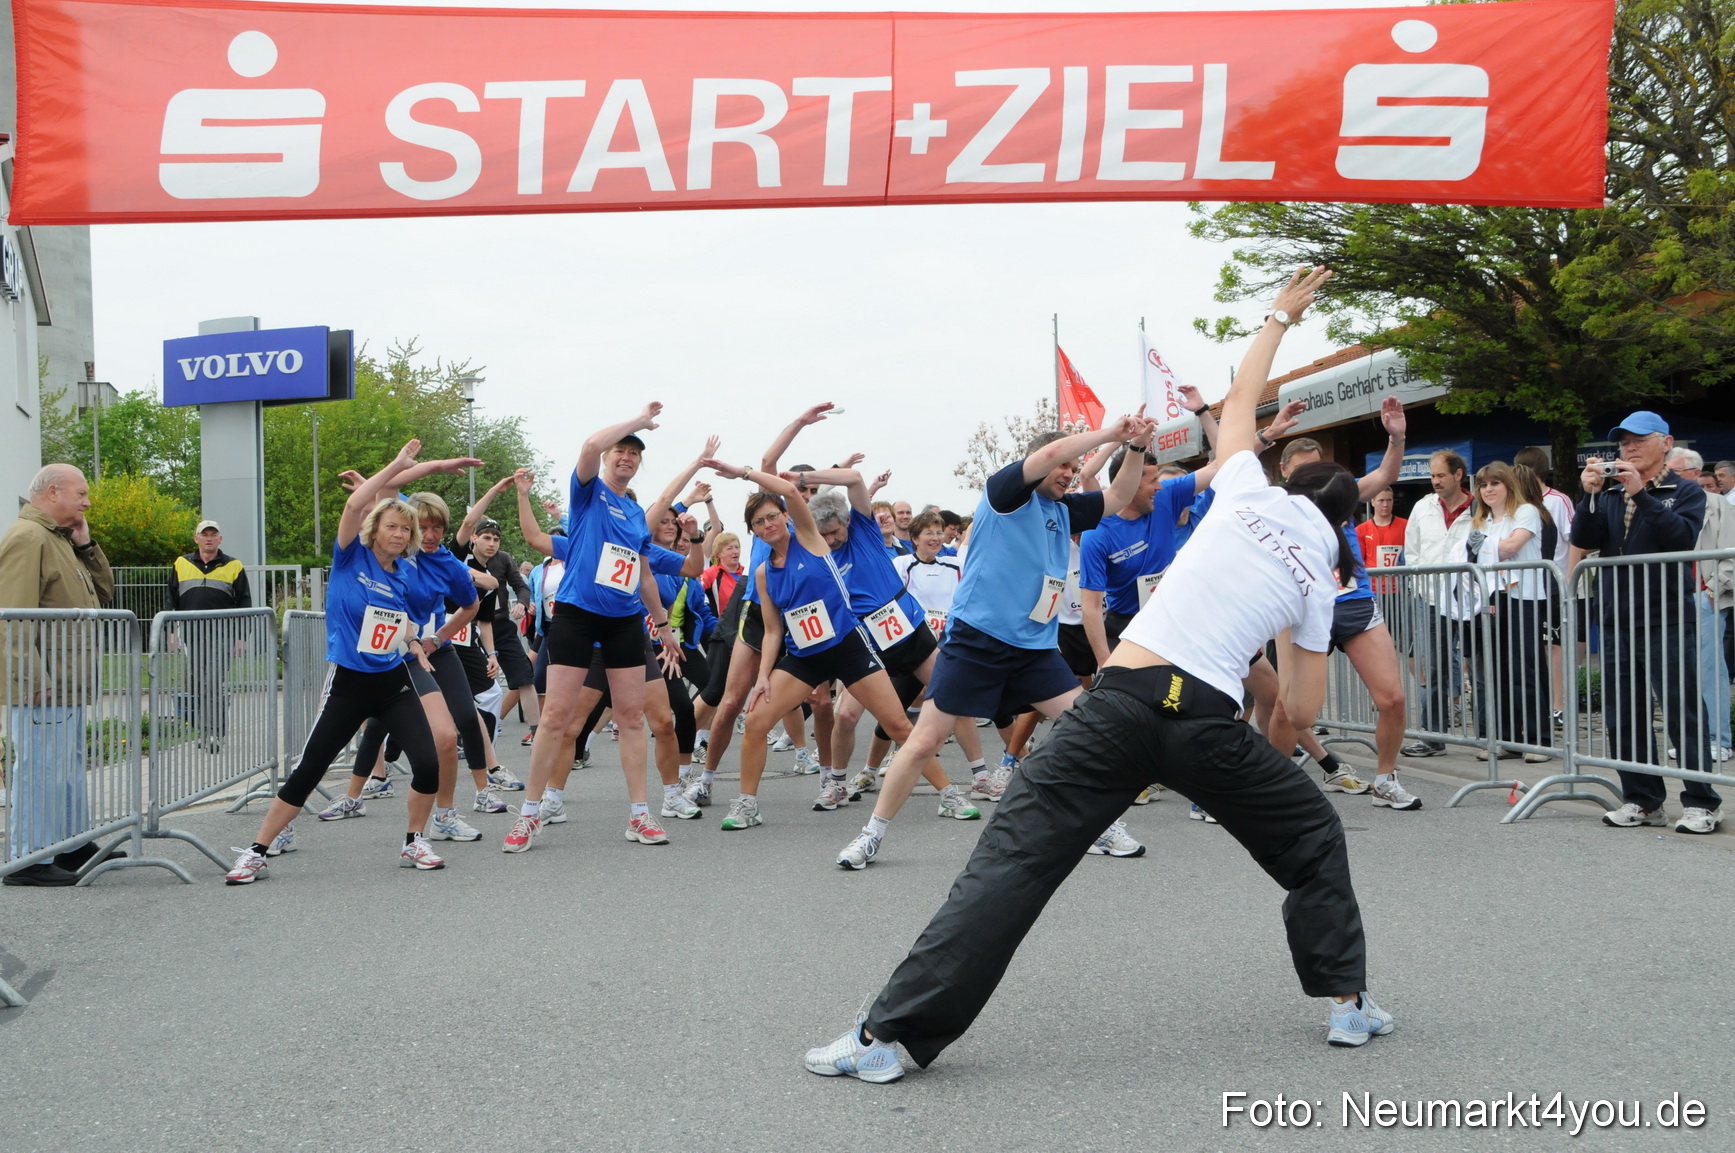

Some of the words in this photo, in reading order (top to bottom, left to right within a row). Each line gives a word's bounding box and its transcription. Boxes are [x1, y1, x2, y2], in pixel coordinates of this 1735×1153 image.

[177, 349, 304, 381] VOLVO
[1287, 391, 1335, 412] ohaus
[1337, 373, 1384, 401] Gerhart
[1387, 367, 1399, 388] &
[1157, 427, 1190, 452] SEAT
[611, 545, 631, 555] MEYER
[1383, 553, 1398, 567] 57
[611, 558, 635, 587] 21
[373, 609, 396, 619] MEYER
[790, 607, 808, 617] MEYER
[870, 608, 888, 621] MEYER
[1047, 592, 1058, 618] 1
[371, 623, 398, 650] 67
[799, 615, 824, 641] 10
[878, 615, 904, 641] 73
